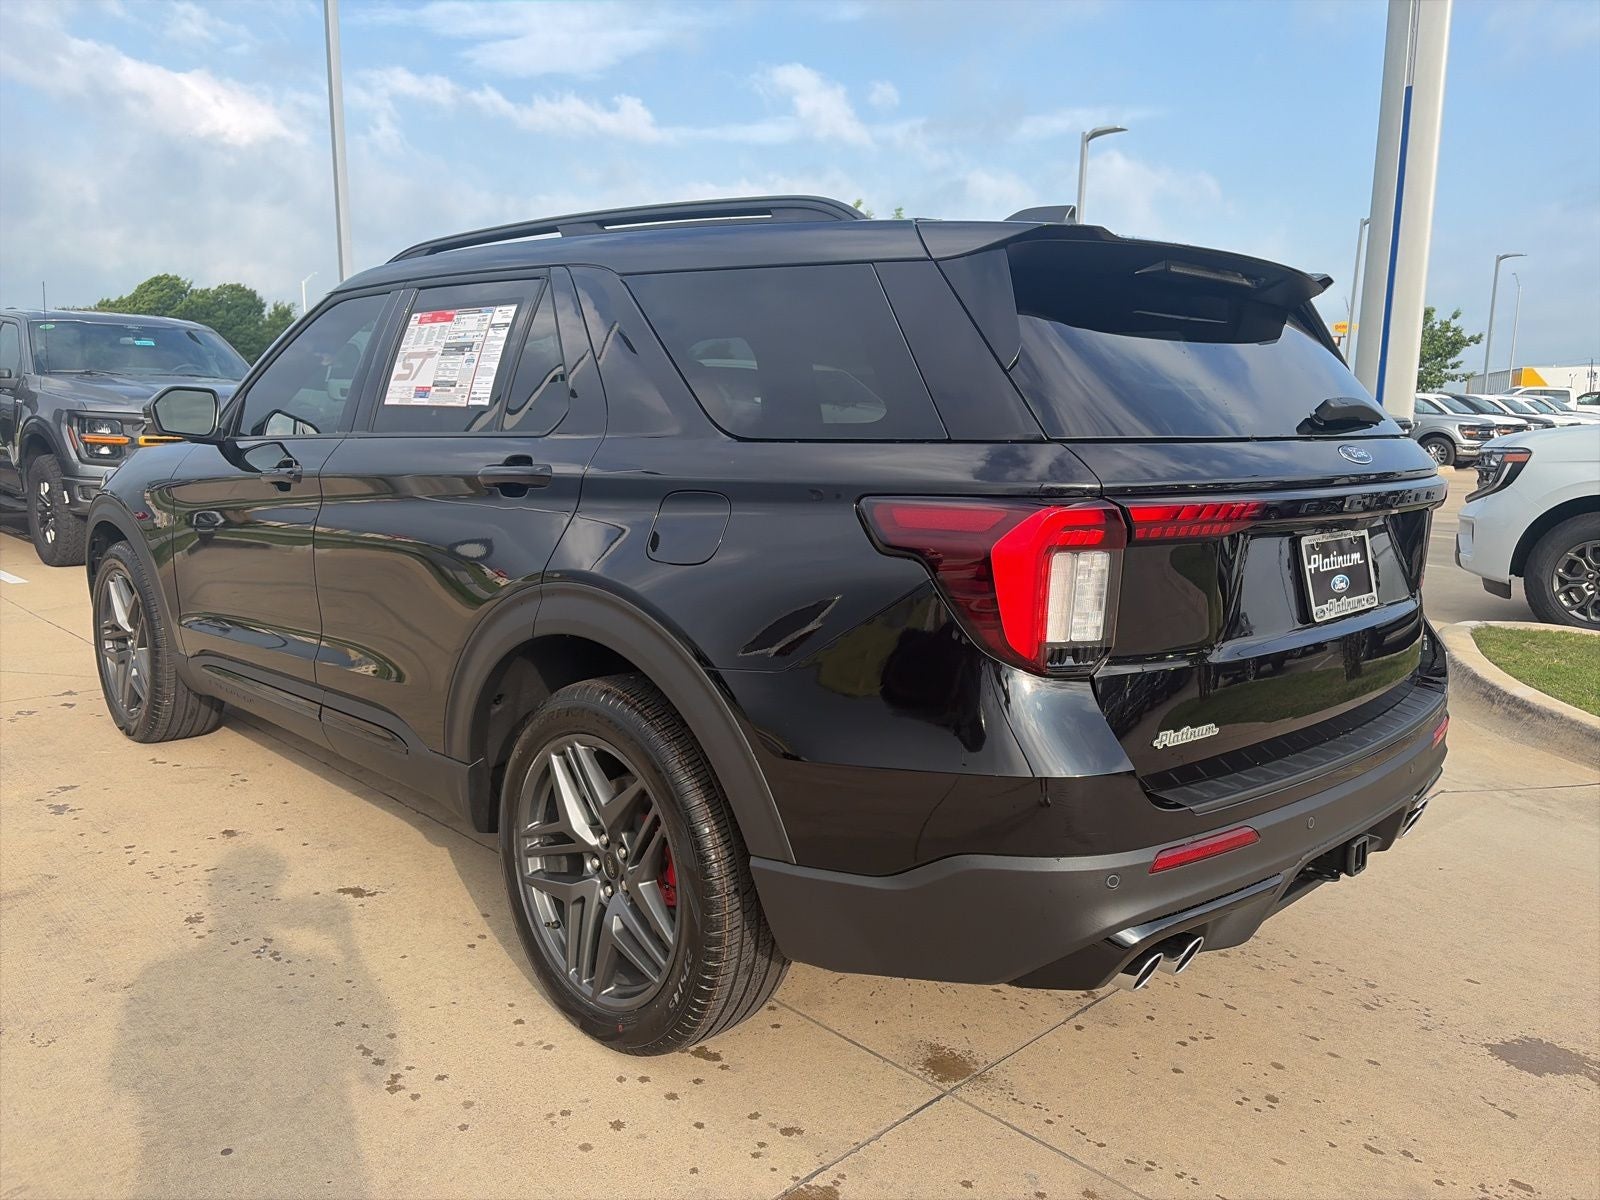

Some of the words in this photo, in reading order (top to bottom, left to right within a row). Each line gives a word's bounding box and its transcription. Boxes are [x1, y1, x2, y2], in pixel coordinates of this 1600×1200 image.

[393, 351, 438, 381] ST
[1308, 551, 1364, 574] Platinum
[1333, 576, 1347, 590] Ford
[1326, 596, 1365, 616] Platinum
[1153, 723, 1220, 749] Platinum
